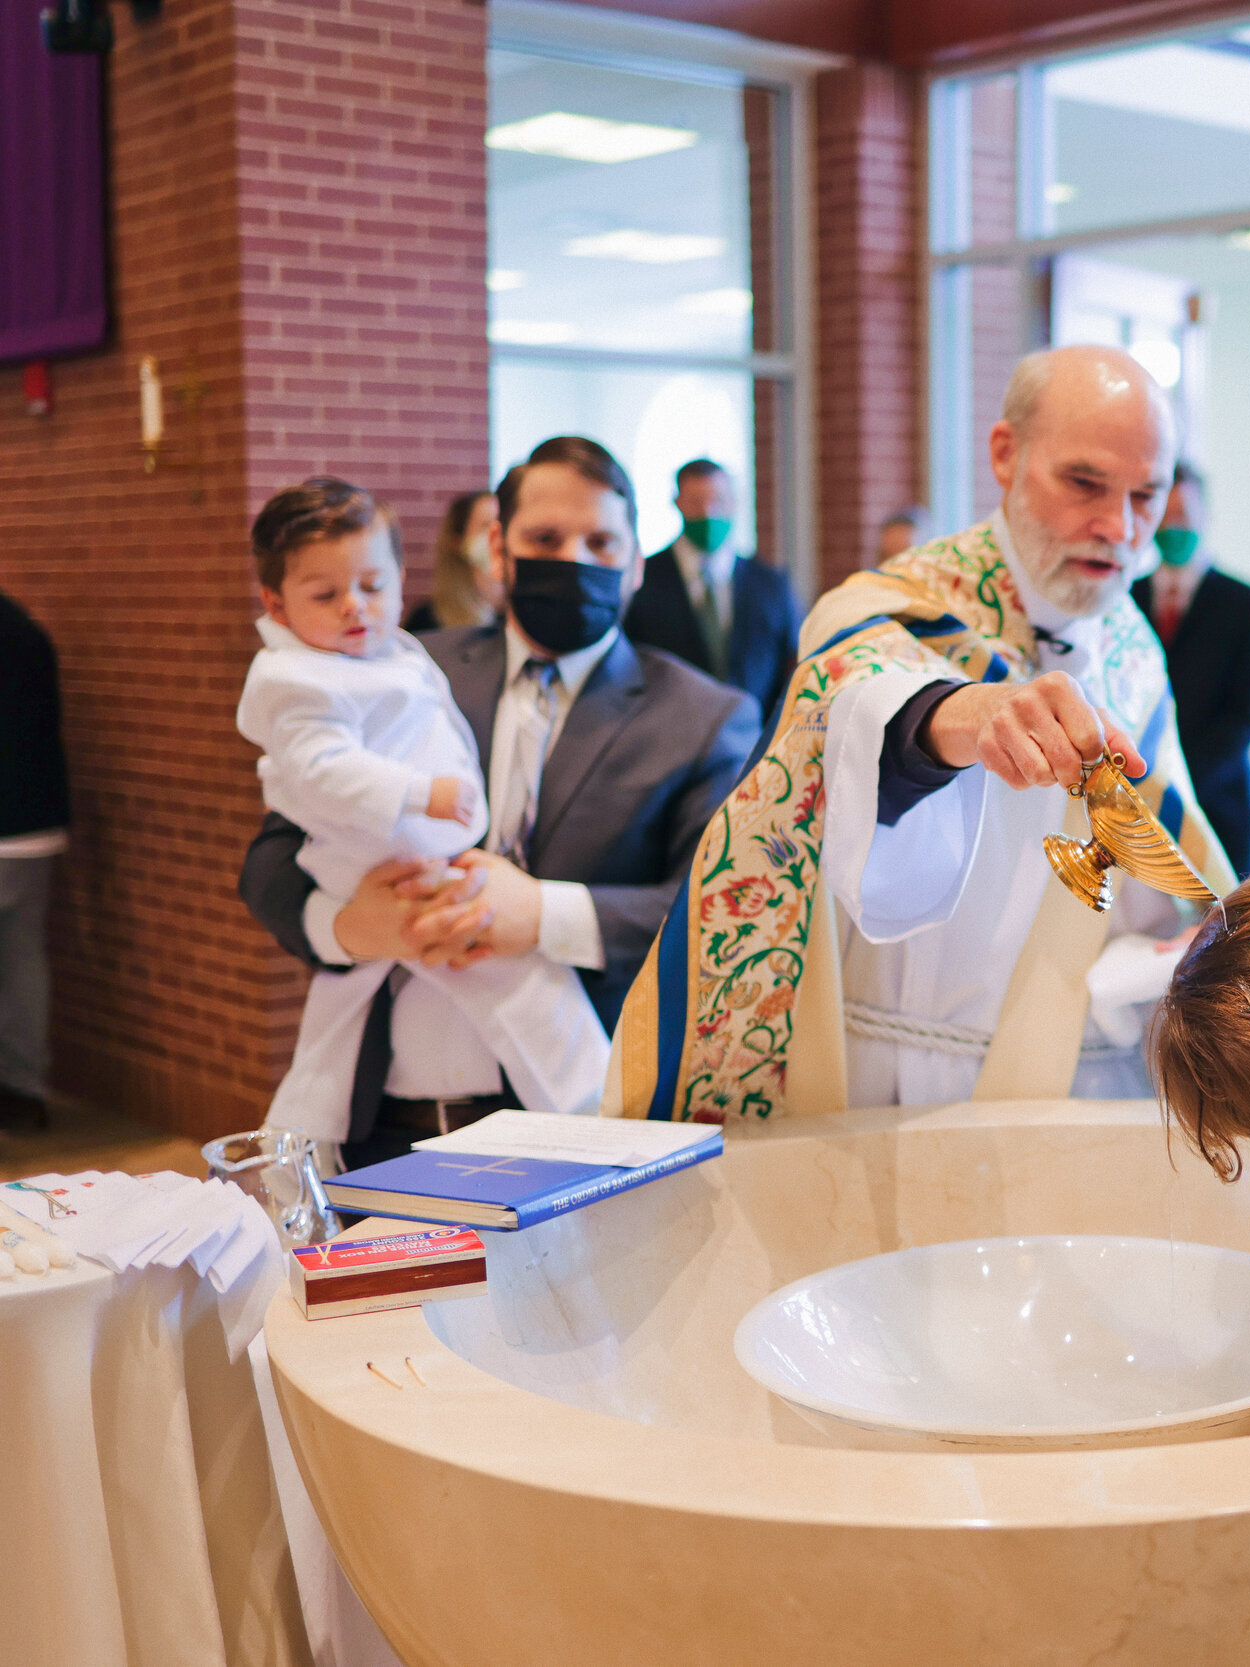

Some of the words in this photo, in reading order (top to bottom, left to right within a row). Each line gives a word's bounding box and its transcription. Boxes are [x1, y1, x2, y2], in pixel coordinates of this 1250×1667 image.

[552, 1196, 569, 1211] THE
[570, 1186, 599, 1204] ORDER
[600, 1181, 611, 1194] OF
[612, 1168, 646, 1190] BAPTISM
[646, 1164, 658, 1177] OF
[658, 1150, 697, 1173] CHILDREN
[339, 1251, 365, 1259] BOX
